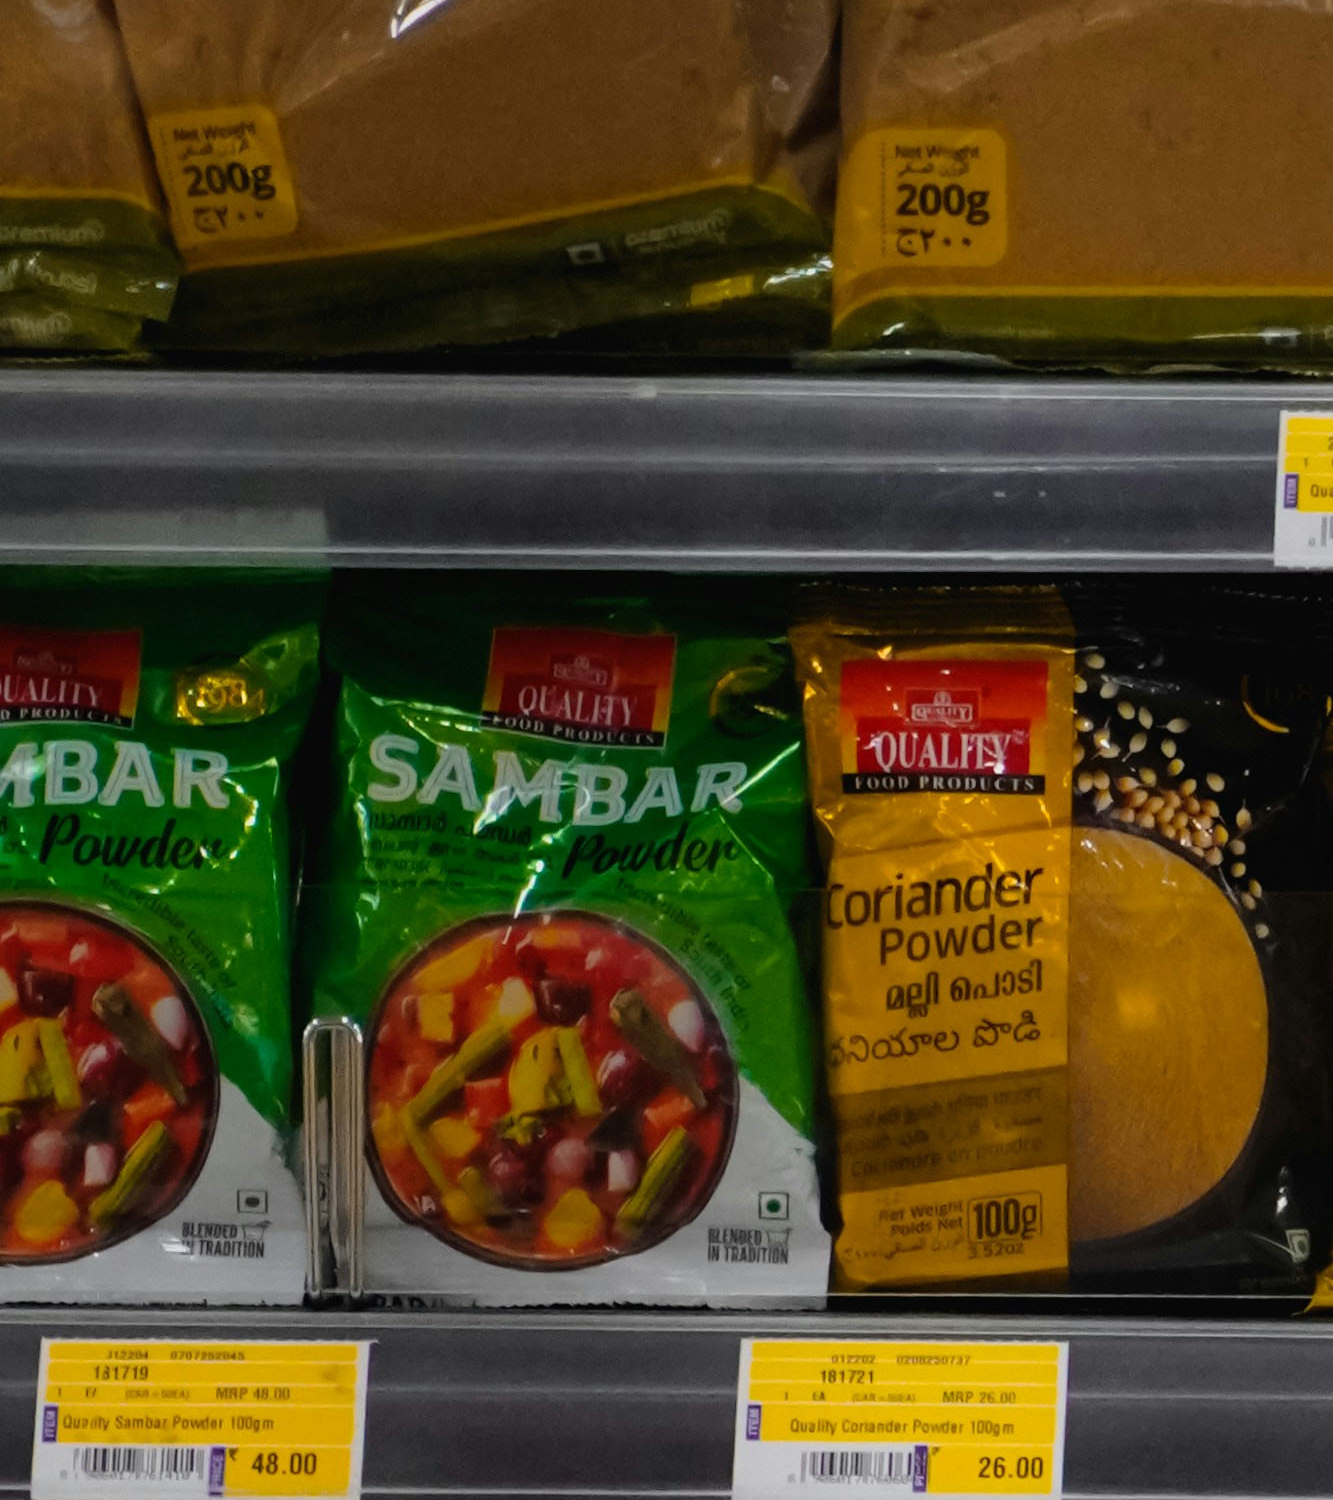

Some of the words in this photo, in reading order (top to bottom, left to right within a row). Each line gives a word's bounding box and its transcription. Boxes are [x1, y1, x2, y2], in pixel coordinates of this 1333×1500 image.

[185, 161, 276, 203] 200g
[518, 685, 639, 727] QUALITY
[368, 734, 749, 828] SAMBAR
[562, 822, 741, 880] Powder
[879, 913, 1043, 964] Powder
[971, 1198, 1038, 1238] 100g
[821, 1370, 874, 1383] 181721
[790, 1418, 837, 1435] Quality
[842, 1419, 907, 1433] Coriander
[912, 1420, 963, 1434] Powder
[970, 1420, 1013, 1436] 100gm
[252, 1453, 317, 1475] 48.00
[979, 1457, 1044, 1479] 26.00
